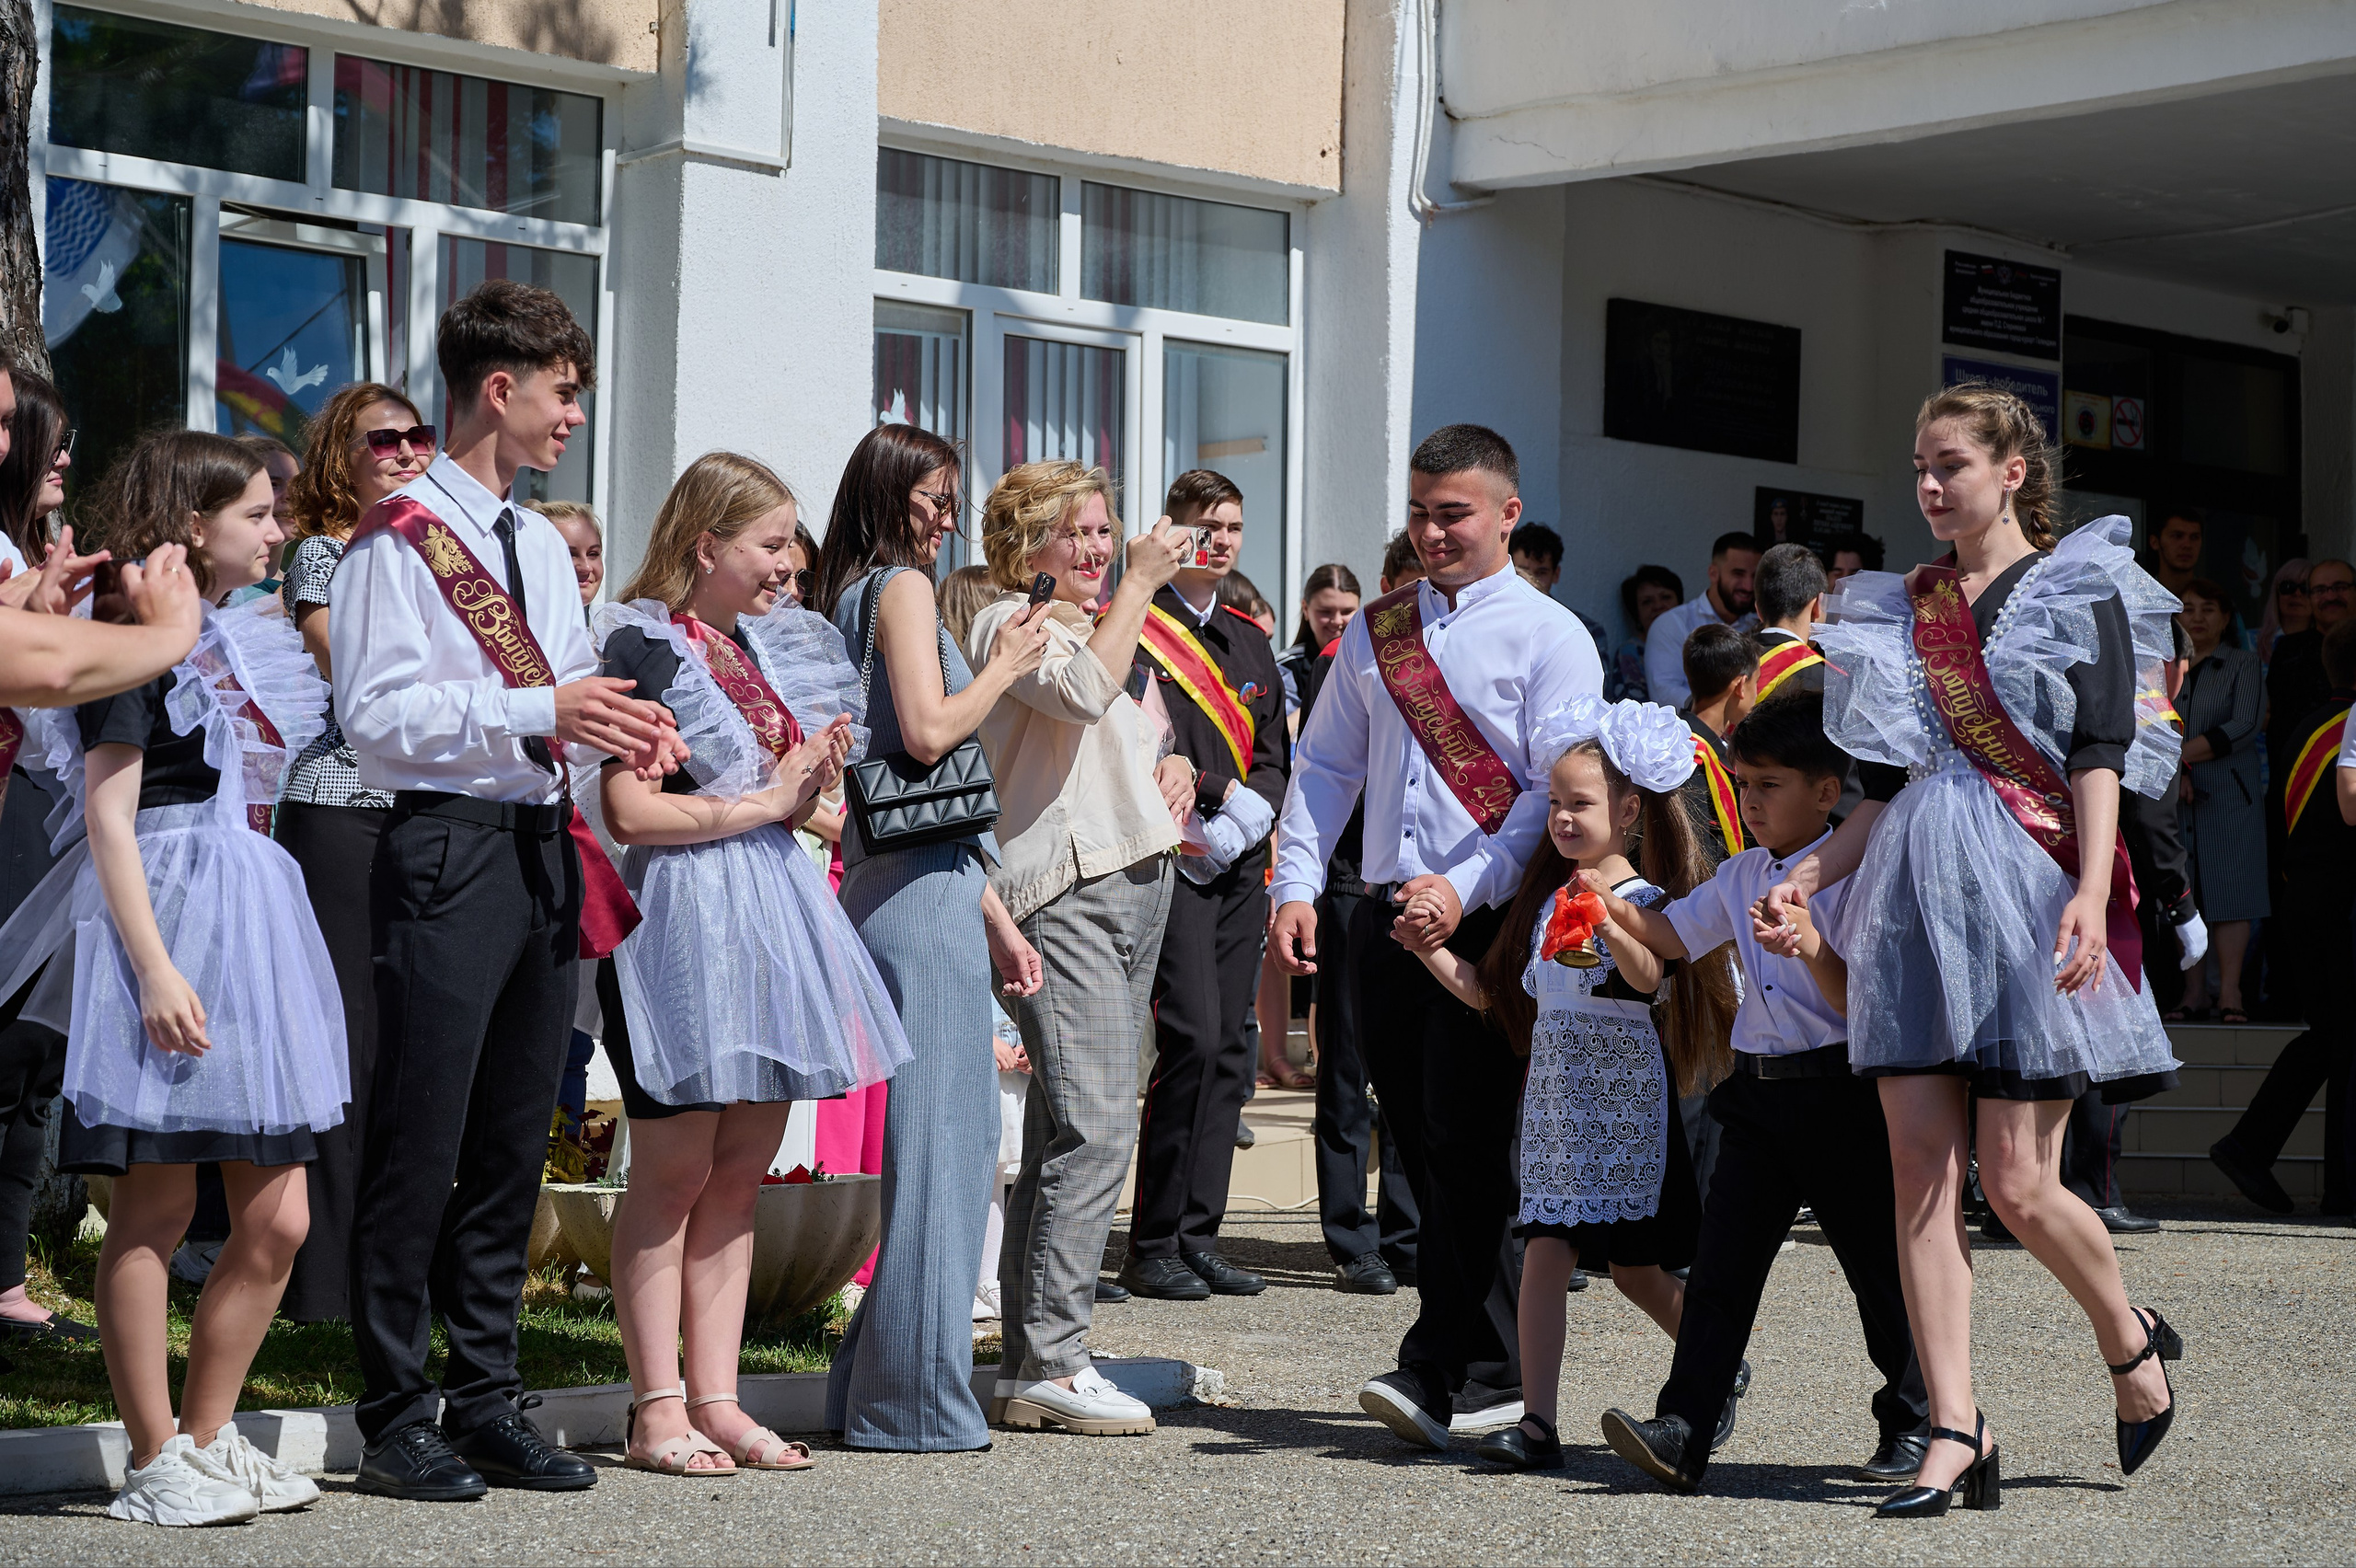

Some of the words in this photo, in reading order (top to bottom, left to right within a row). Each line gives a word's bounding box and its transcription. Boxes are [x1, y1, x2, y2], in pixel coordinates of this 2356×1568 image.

[452, 579, 551, 688] Выпуск
[1380, 638, 1486, 786] Выпускник
[1916, 627, 2032, 790] Выпускница
